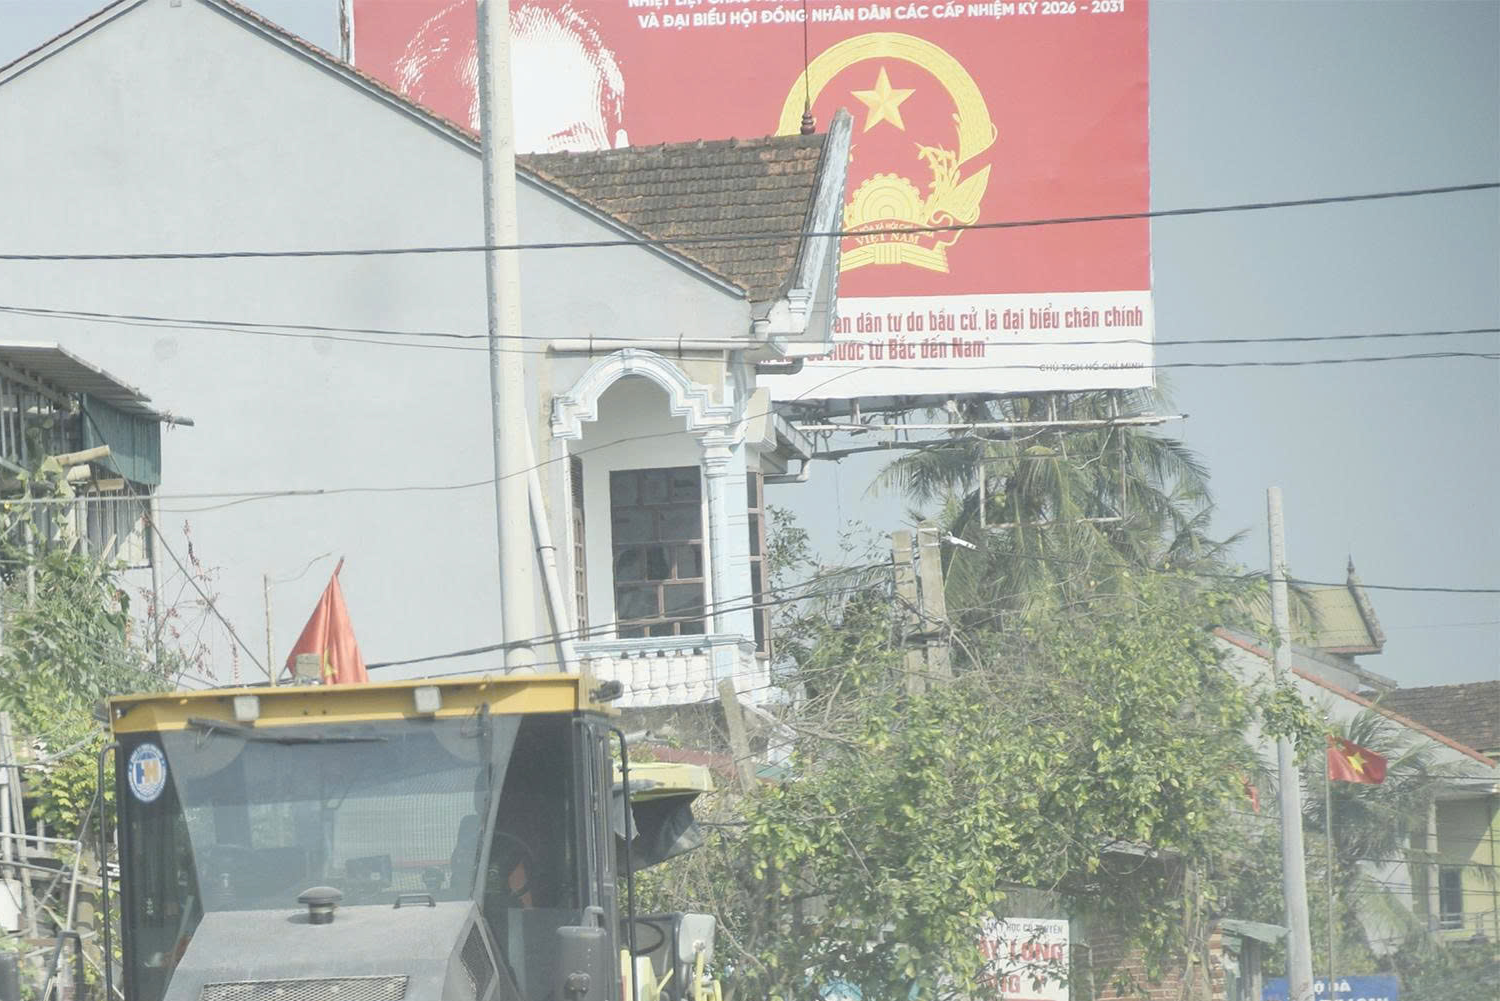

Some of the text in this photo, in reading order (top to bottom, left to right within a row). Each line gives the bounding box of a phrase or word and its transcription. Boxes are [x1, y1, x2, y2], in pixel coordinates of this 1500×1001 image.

[638, 12, 659, 28] VÀ
[663, 13, 690, 30] ĐẠI
[730, 8, 757, 28] HỘI
[812, 5, 854, 22] NHÂN
[858, 4, 891, 20] DÂN
[895, 3, 929, 19] CÁC
[932, 1, 964, 18] CẤP
[968, 0, 1015, 20] NHIỆM
[1041, 1, 1077, 15] 2026
[1091, 0, 1125, 13] 2031
[857, 311, 882, 333] dân
[907, 312, 923, 332] do
[986, 309, 997, 330] là
[1003, 308, 1024, 335] đại
[1030, 302, 1060, 330] biểu
[1065, 307, 1100, 328] chân
[1105, 305, 1143, 327] chính
[889, 336, 915, 360] Bắc
